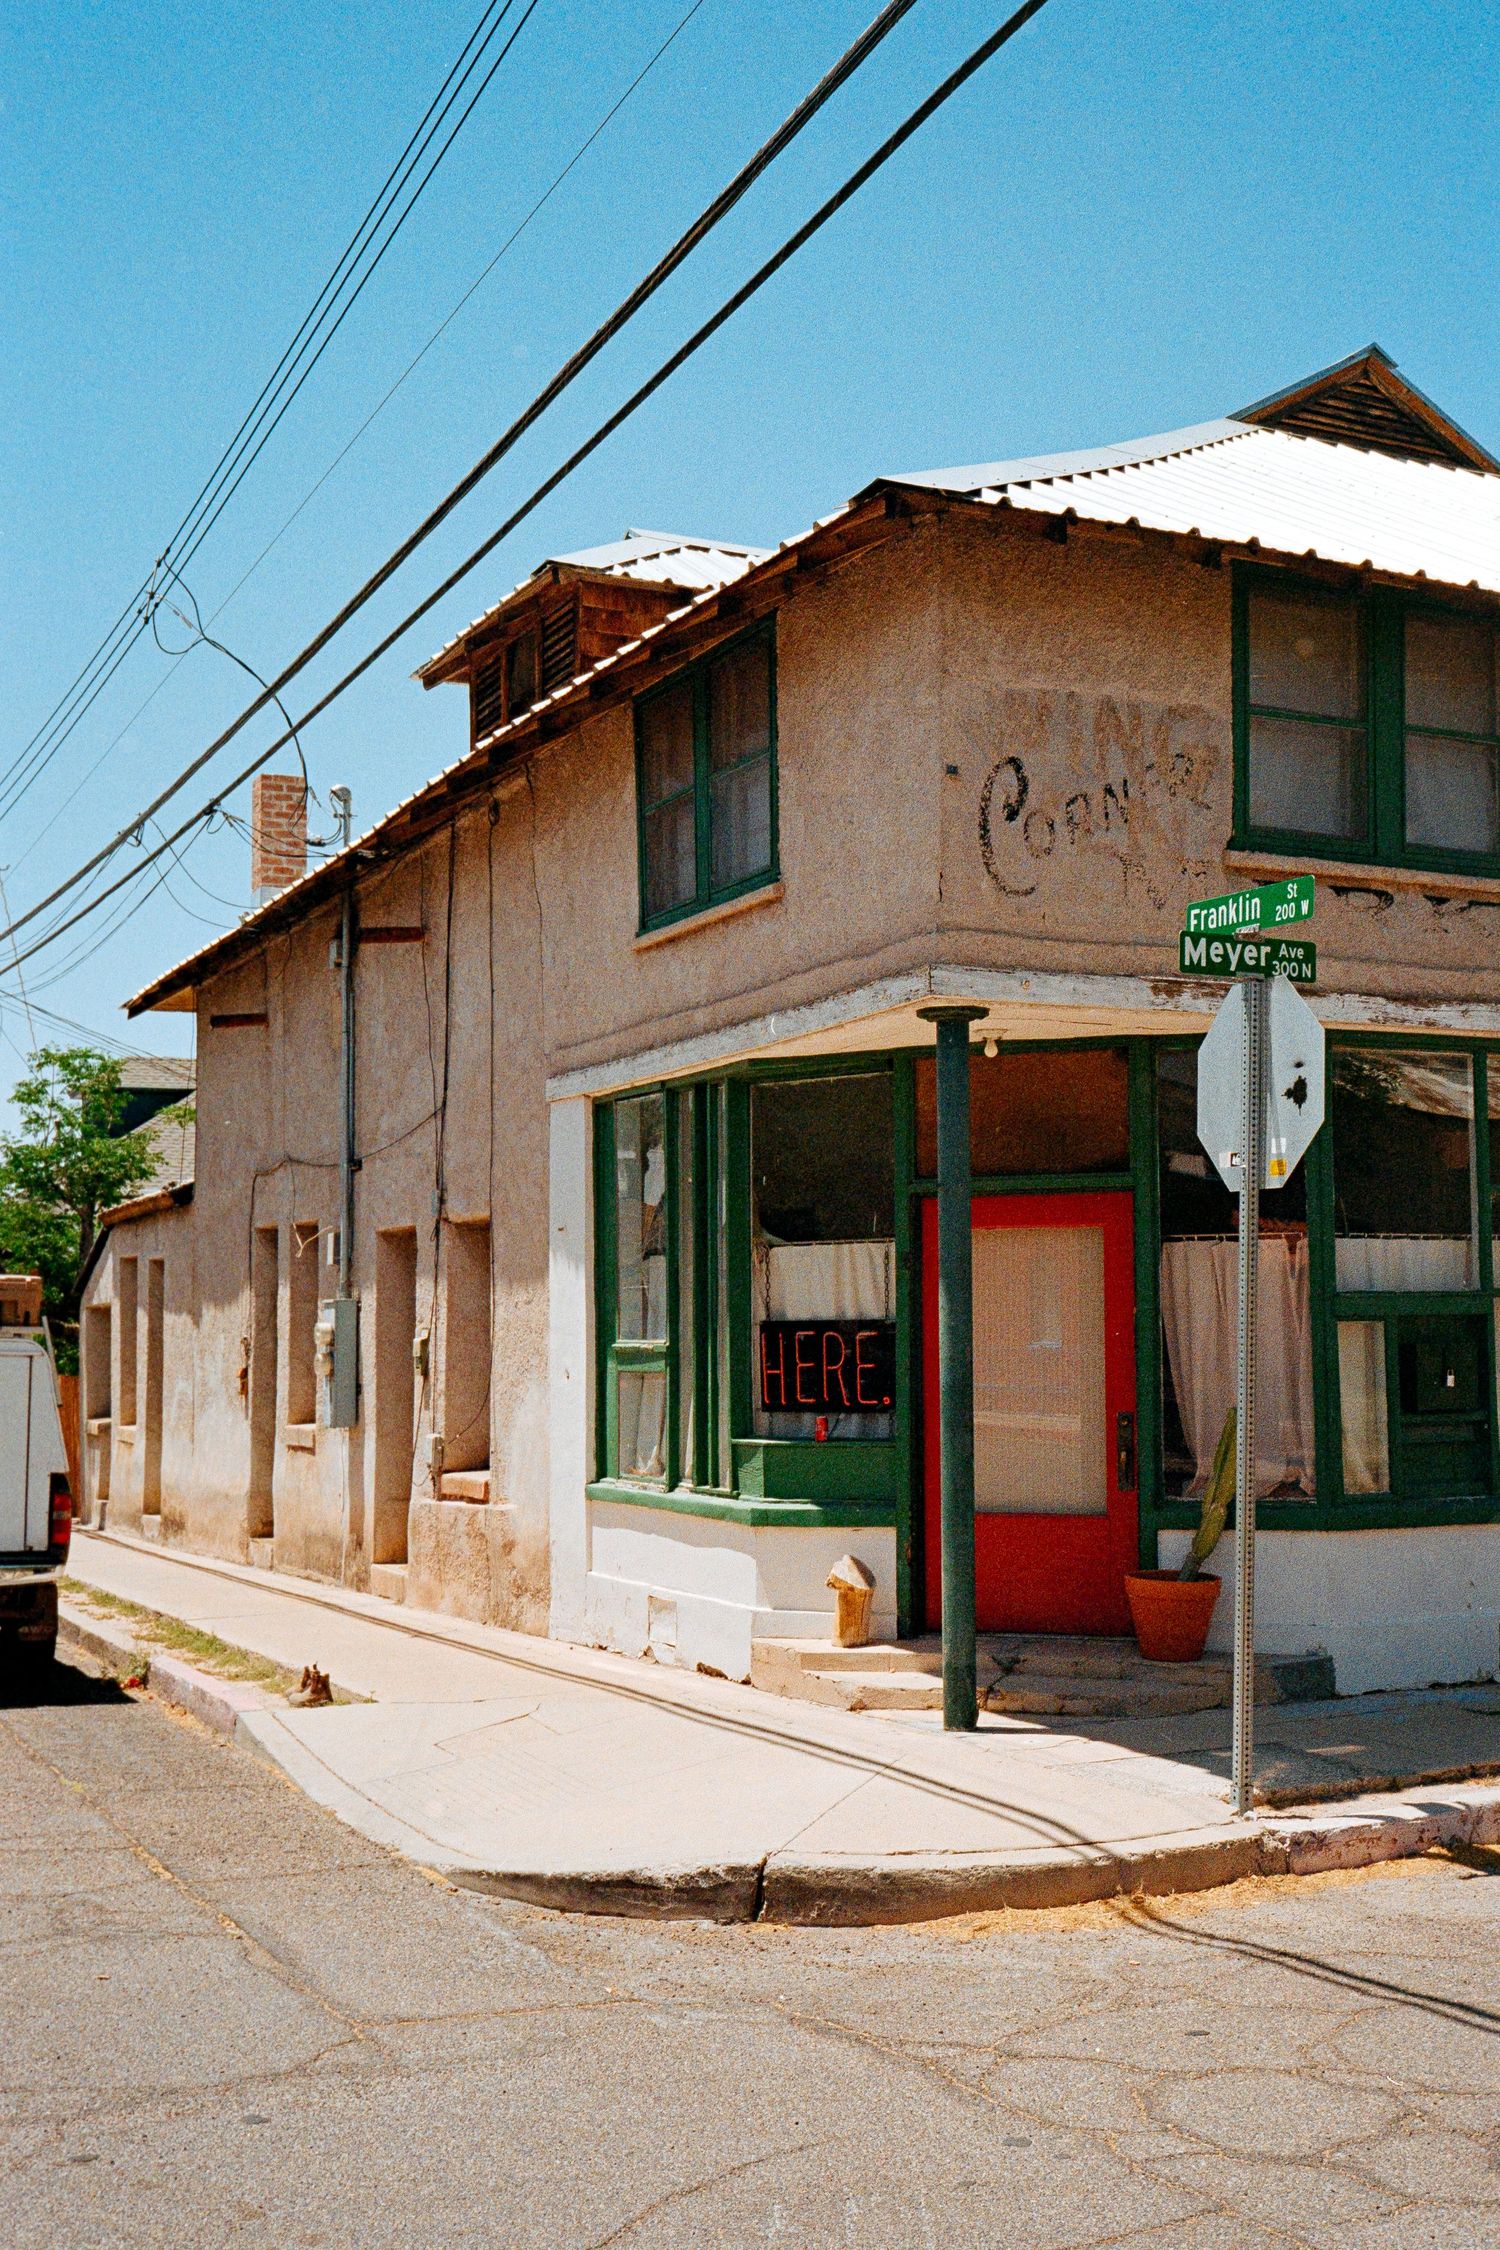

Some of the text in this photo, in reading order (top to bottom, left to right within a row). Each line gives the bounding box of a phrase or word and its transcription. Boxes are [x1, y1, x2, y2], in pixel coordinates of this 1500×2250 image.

[1190, 883, 1298, 932] Franklin St
[1275, 899, 1309, 921] 200 W
[1184, 936, 1304, 971] Meyer Ave
[1272, 961, 1312, 978] 300 N
[761, 1331, 891, 1406] HERE.
